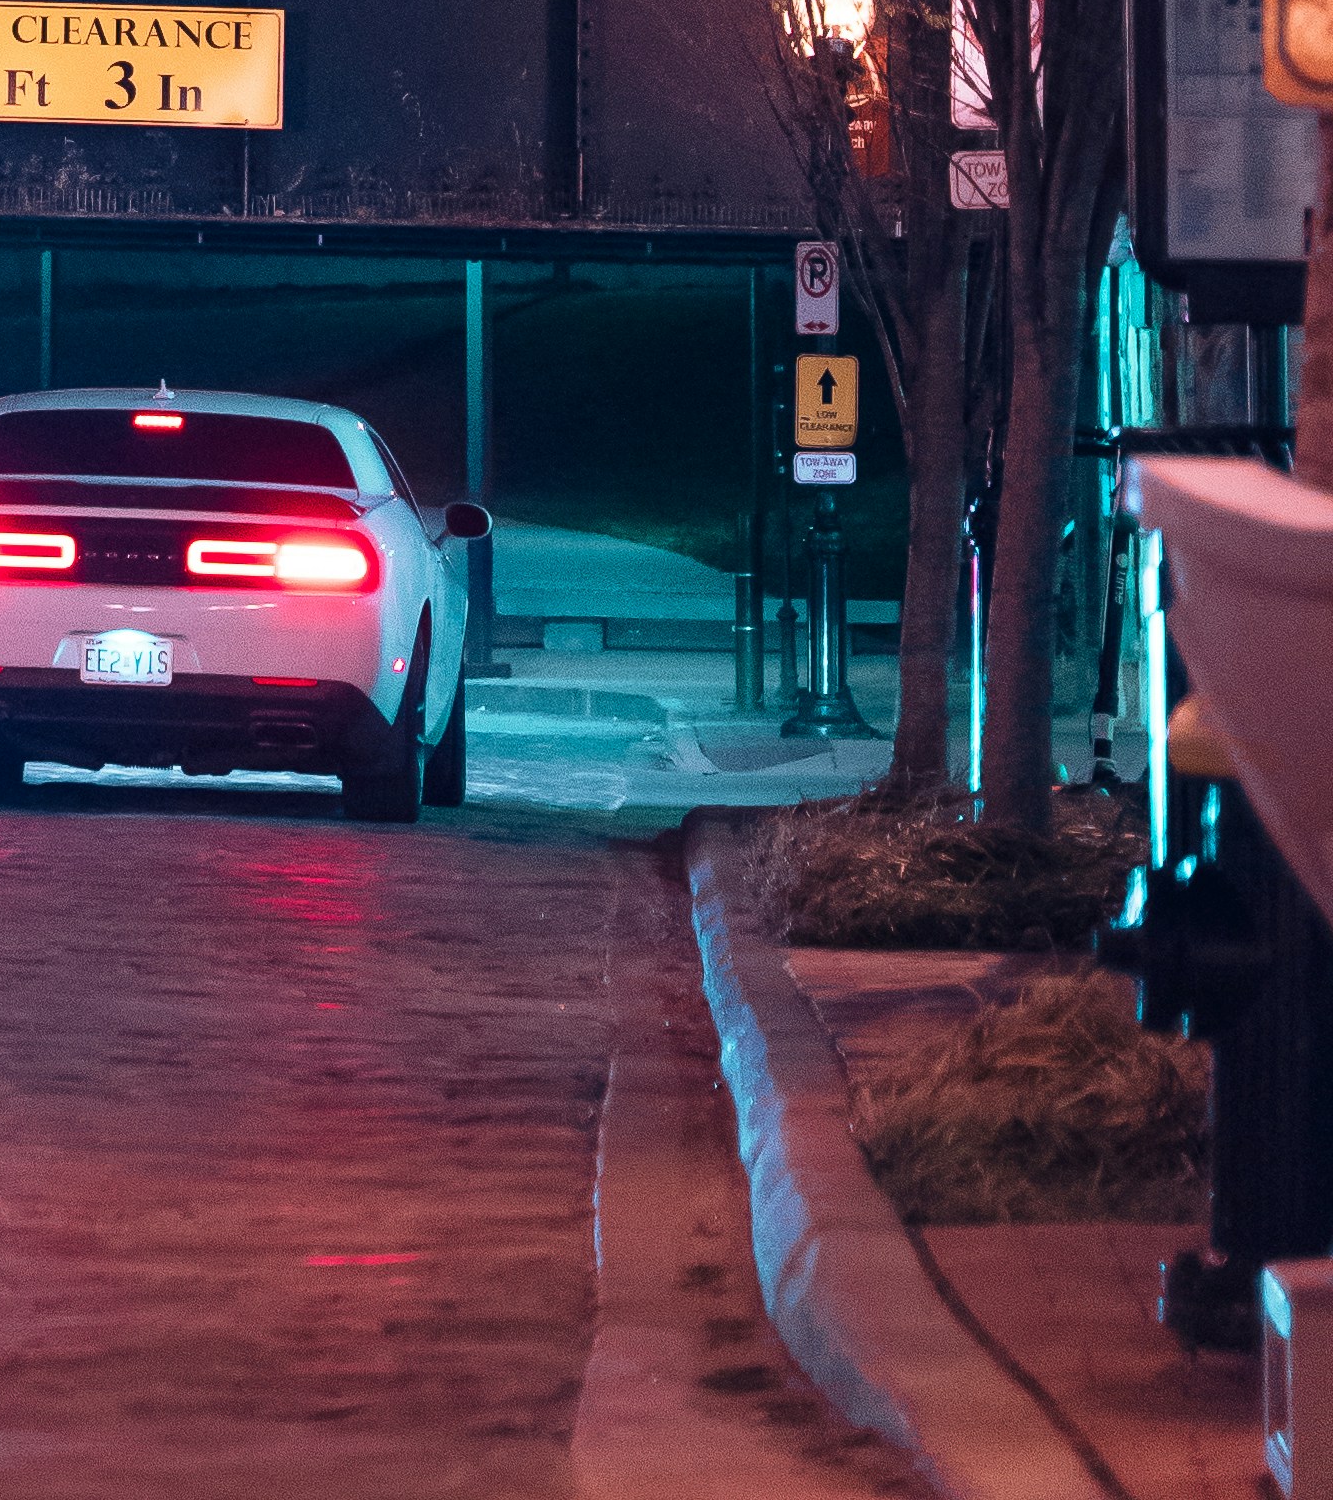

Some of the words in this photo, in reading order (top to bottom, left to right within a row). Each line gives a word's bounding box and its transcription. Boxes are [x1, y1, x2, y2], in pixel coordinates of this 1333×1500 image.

[11, 14, 253, 50] CLEARANCE
[3, 68, 52, 107] Ft
[104, 60, 137, 110] 3
[157, 73, 204, 112] In
[987, 181, 1009, 198] ZO
[816, 410, 838, 419] LOW
[799, 422, 854, 433] CLEARANCE
[800, 456, 849, 467] TOW-AWAY
[812, 468, 837, 479] ZONE
